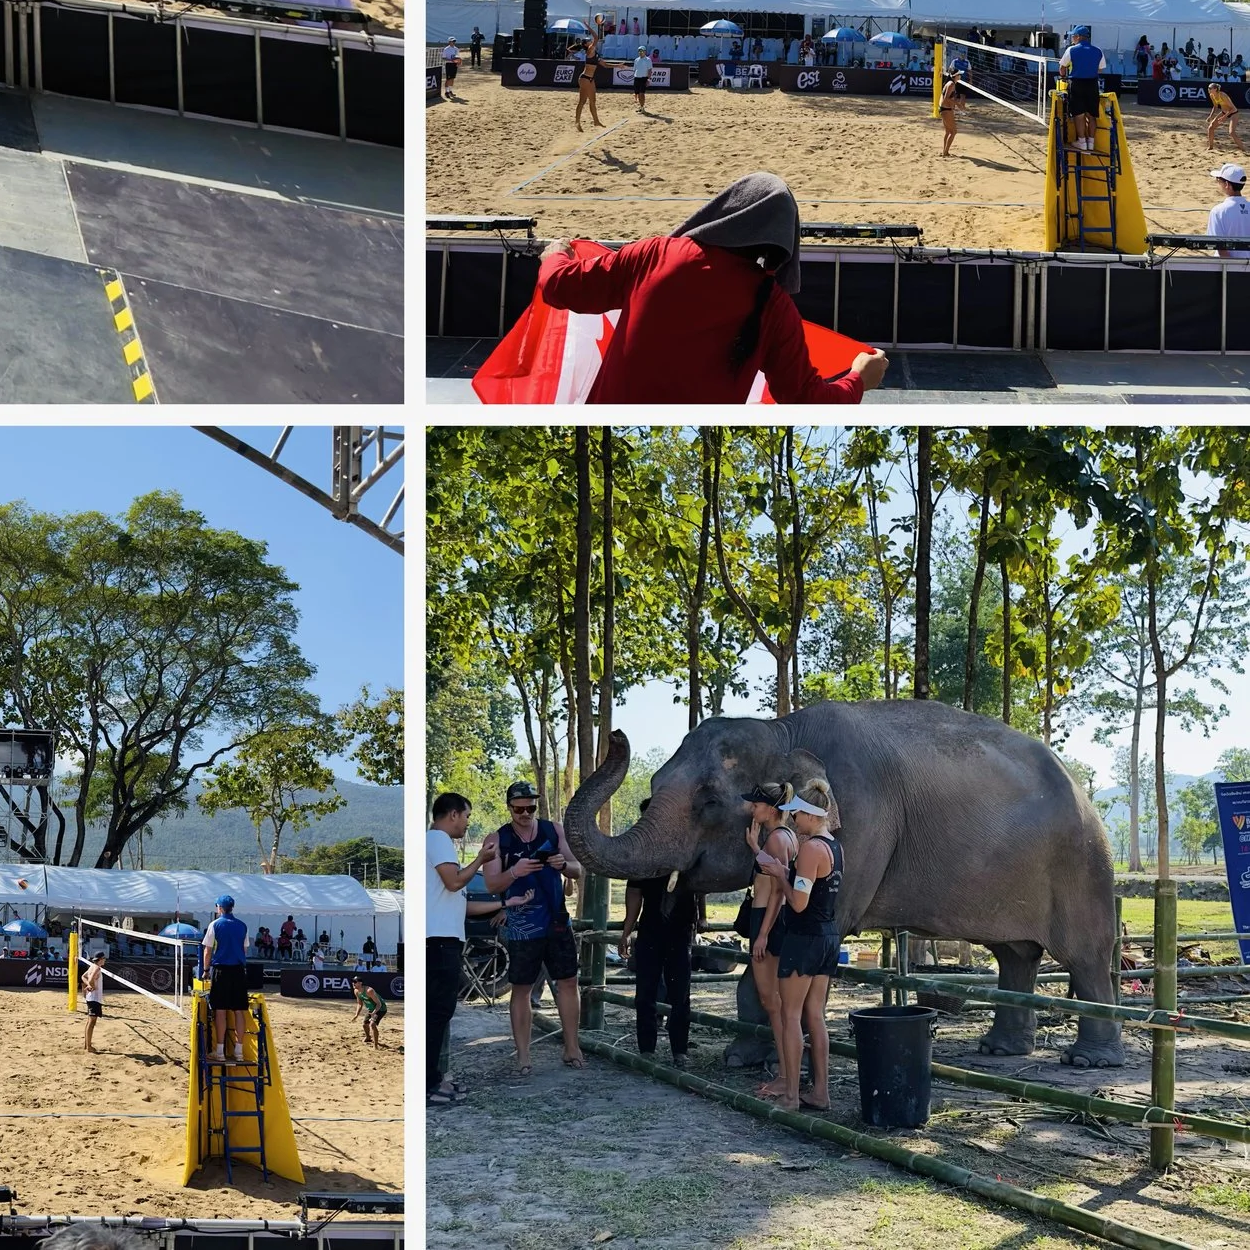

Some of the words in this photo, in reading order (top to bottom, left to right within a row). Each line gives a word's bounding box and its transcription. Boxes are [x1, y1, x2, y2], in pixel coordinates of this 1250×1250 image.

[797, 70, 820, 88] est
[909, 77, 932, 86] NSD
[1180, 87, 1206, 98] PEA
[46, 967, 68, 977] NSD
[323, 978, 350, 988] PEA
